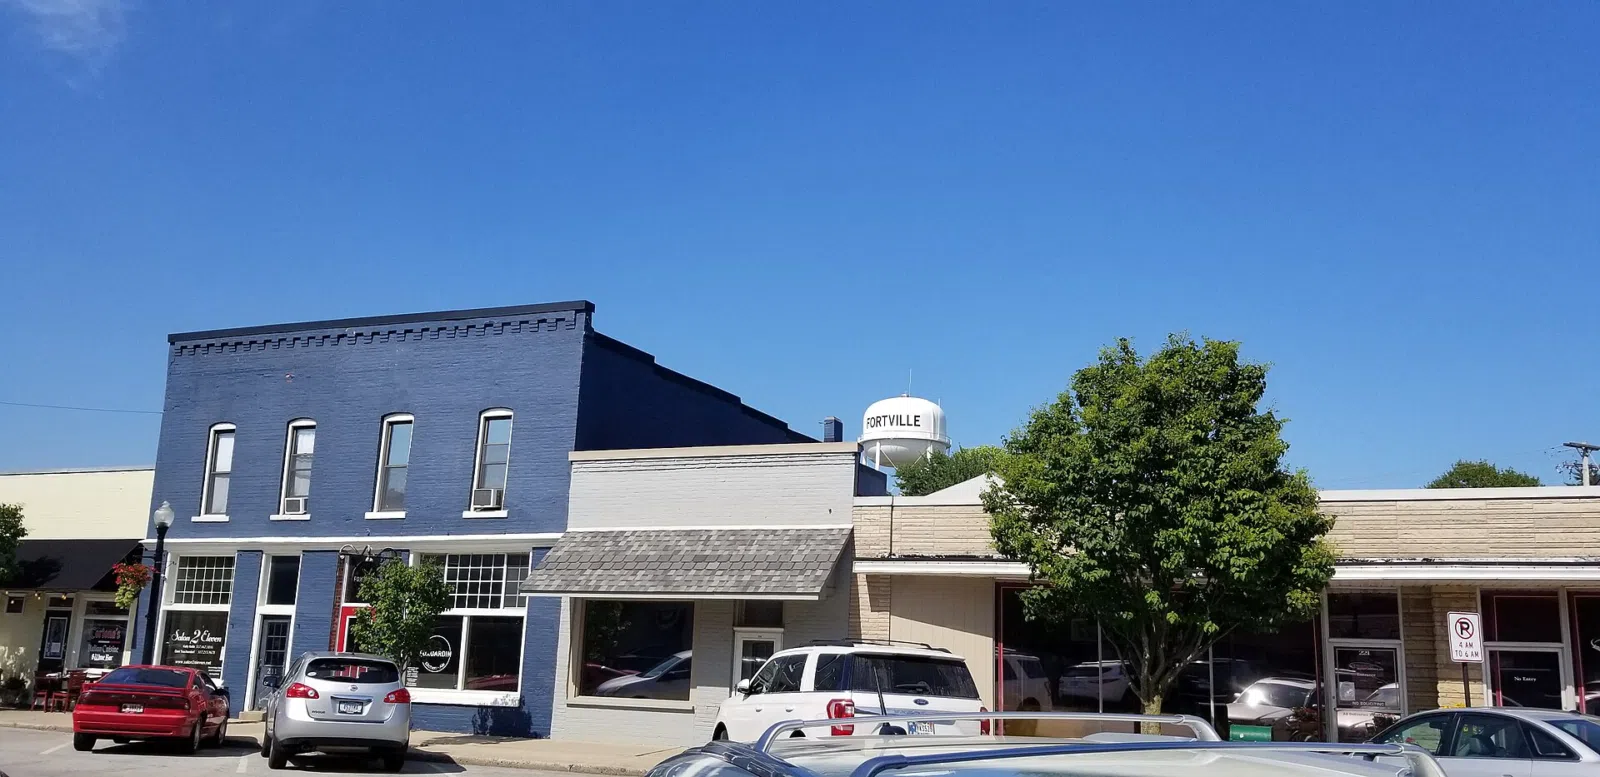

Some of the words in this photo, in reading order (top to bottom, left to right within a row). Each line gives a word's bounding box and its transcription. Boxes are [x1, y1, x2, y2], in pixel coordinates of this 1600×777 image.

[866, 414, 921, 429] FORTVILLE
[171, 629, 191, 642] Salon
[189, 629, 201, 644] 2
[200, 630, 222, 643] Eleven
[266, 667, 277, 675] 211
